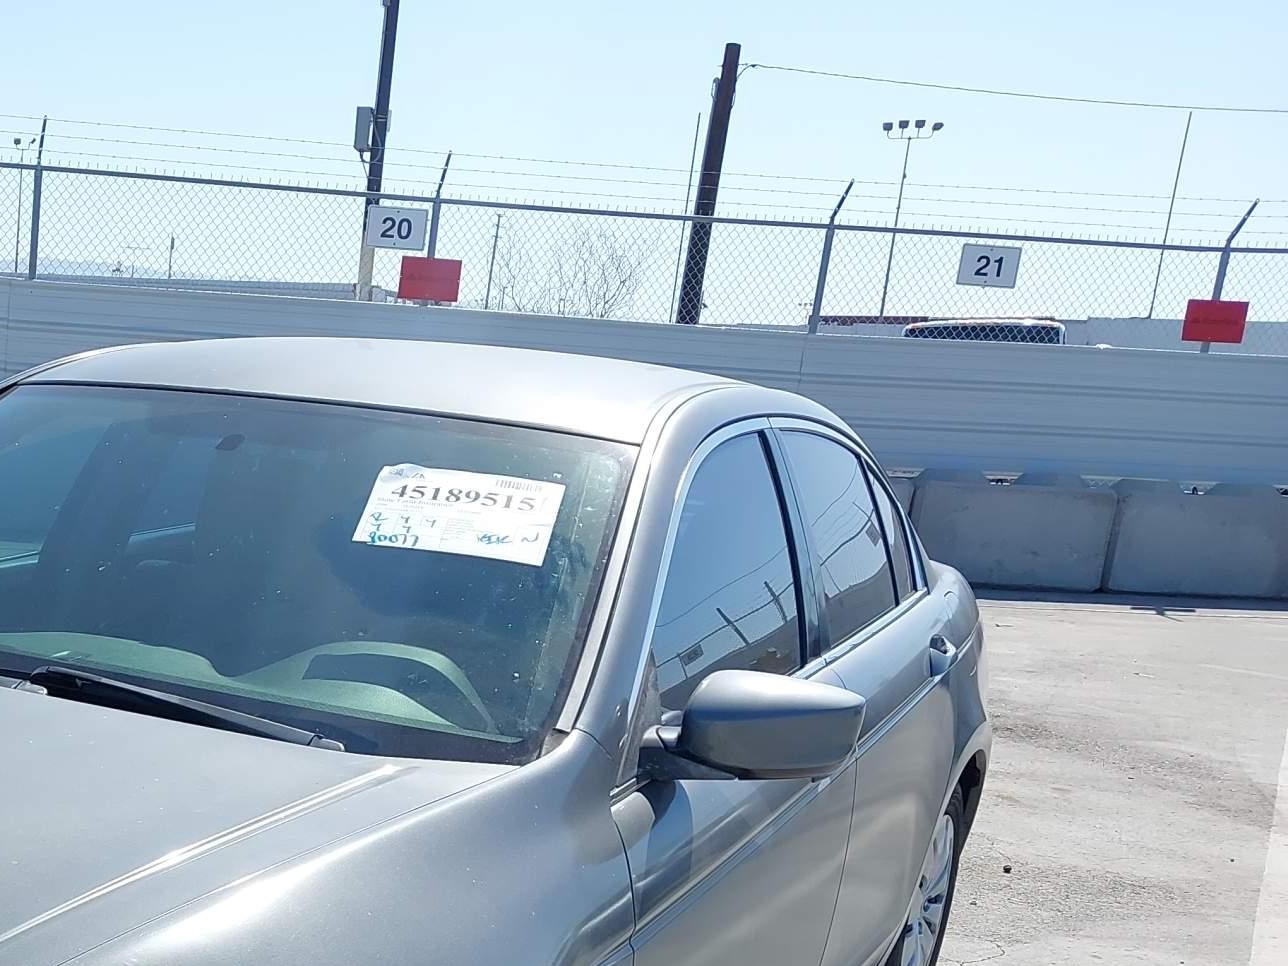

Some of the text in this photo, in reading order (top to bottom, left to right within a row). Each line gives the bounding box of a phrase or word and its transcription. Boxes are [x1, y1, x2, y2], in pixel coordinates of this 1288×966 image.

[380, 216, 412, 240] 20
[973, 255, 1005, 278] 21
[391, 483, 537, 512] 45189515
